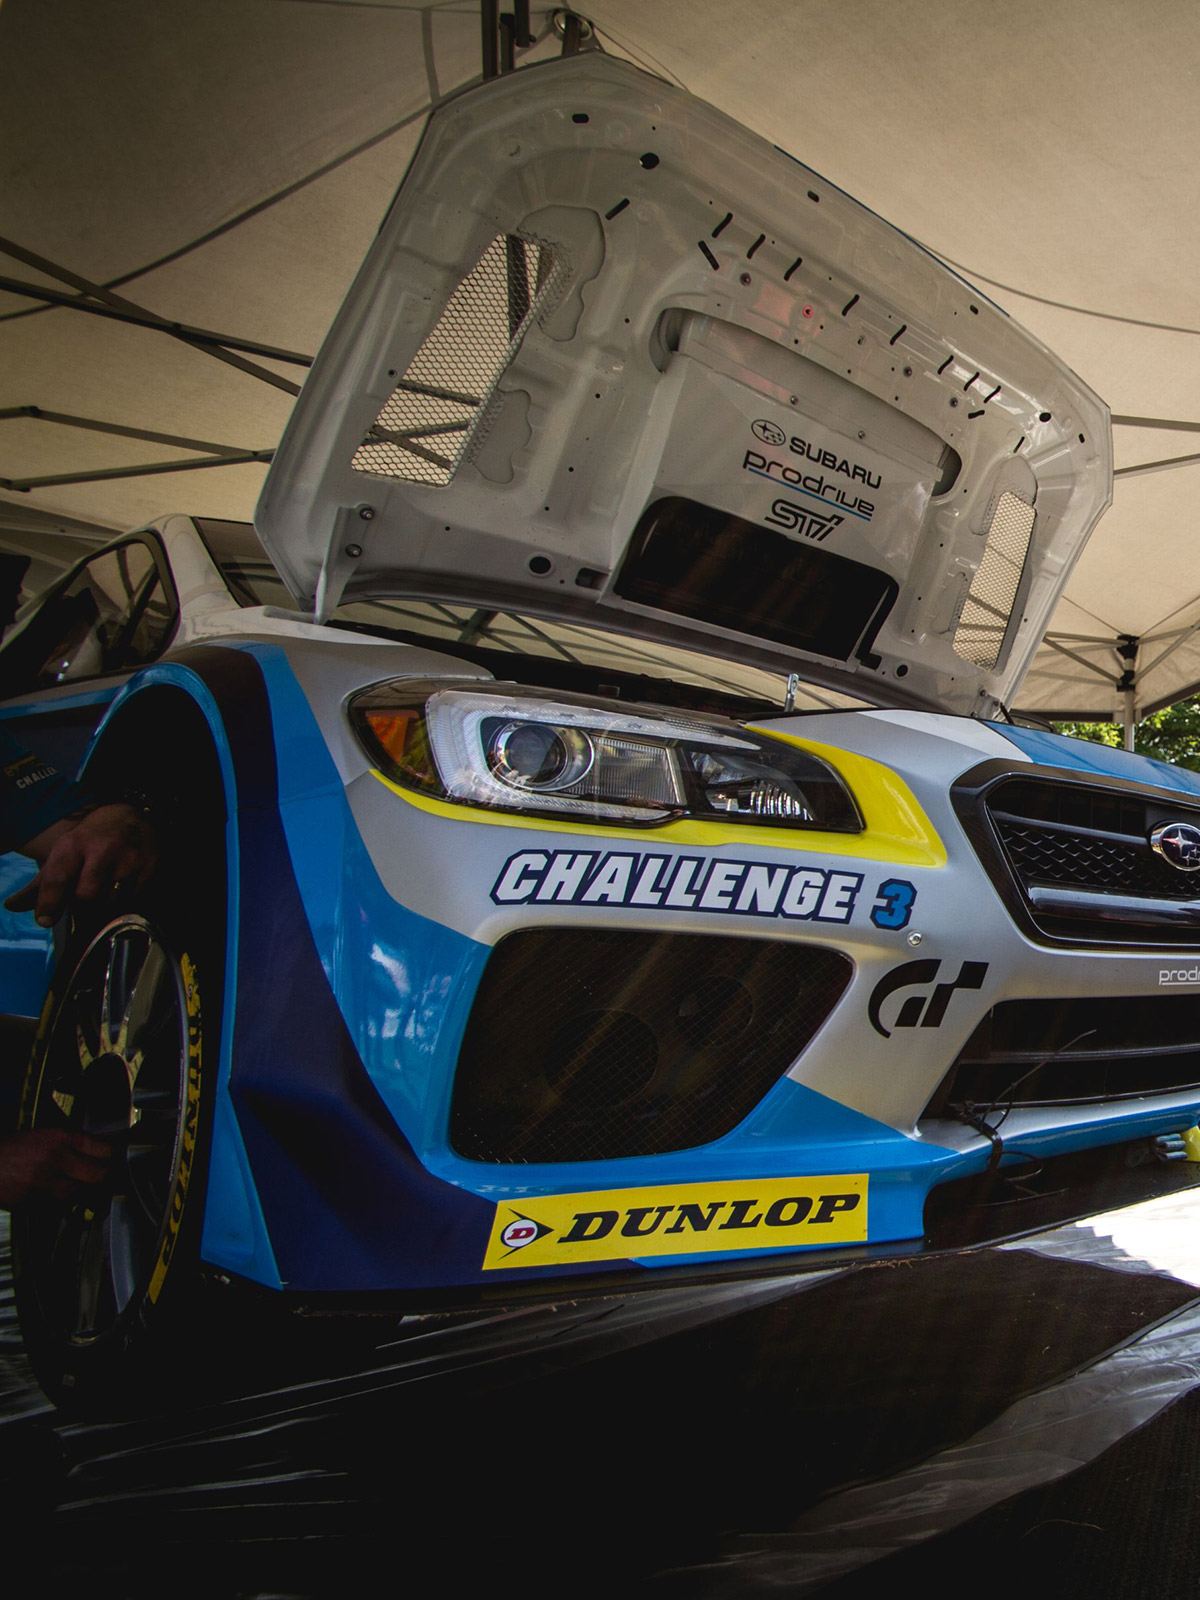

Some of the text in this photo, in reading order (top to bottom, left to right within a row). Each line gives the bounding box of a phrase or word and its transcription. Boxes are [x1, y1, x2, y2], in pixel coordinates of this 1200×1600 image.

[789, 436, 882, 490] SUBARU
[489, 849, 918, 931] CHALLENGE 3
[557, 1193, 861, 1244] DUNLOP
